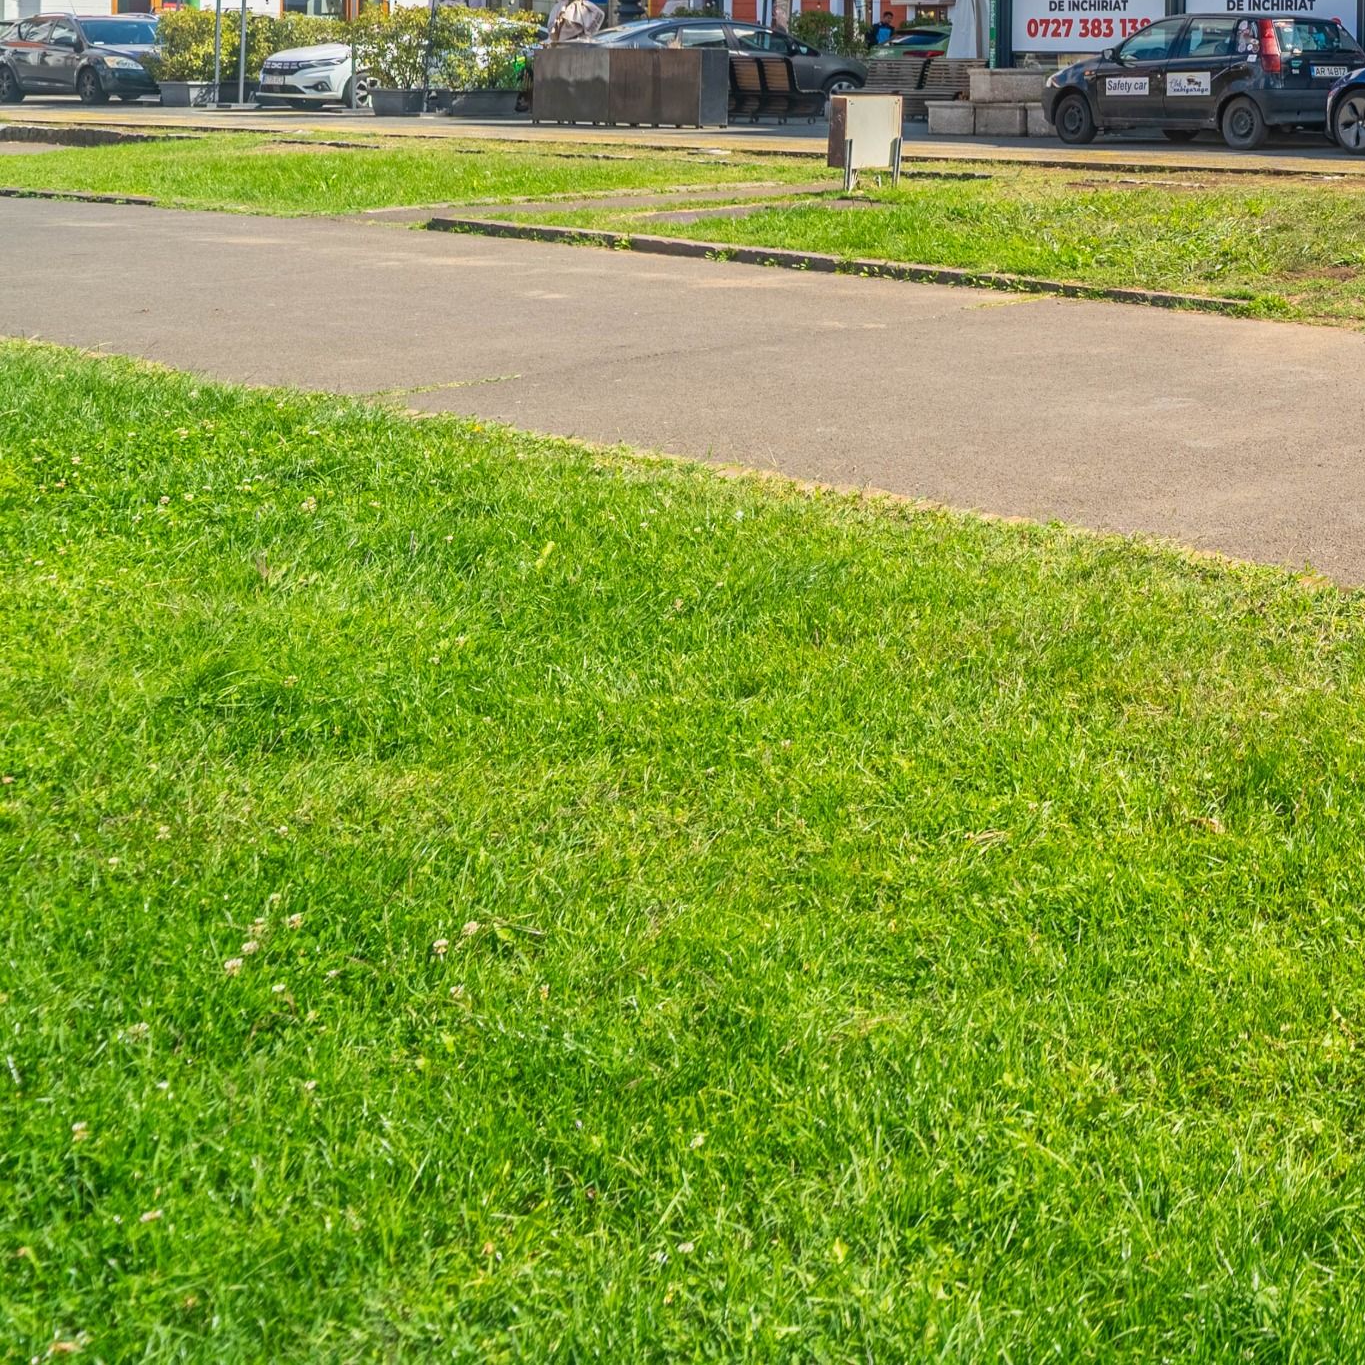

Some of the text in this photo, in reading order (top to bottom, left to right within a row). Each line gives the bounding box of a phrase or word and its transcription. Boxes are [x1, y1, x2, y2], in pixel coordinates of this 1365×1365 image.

[1048, 0, 1065, 11] DE
[1226, 0, 1244, 11] DE
[1026, 18, 1073, 37] 0727
[1079, 18, 1114, 37] 383
[1315, 67, 1326, 76] AR
[1107, 79, 1148, 92] Safety car
